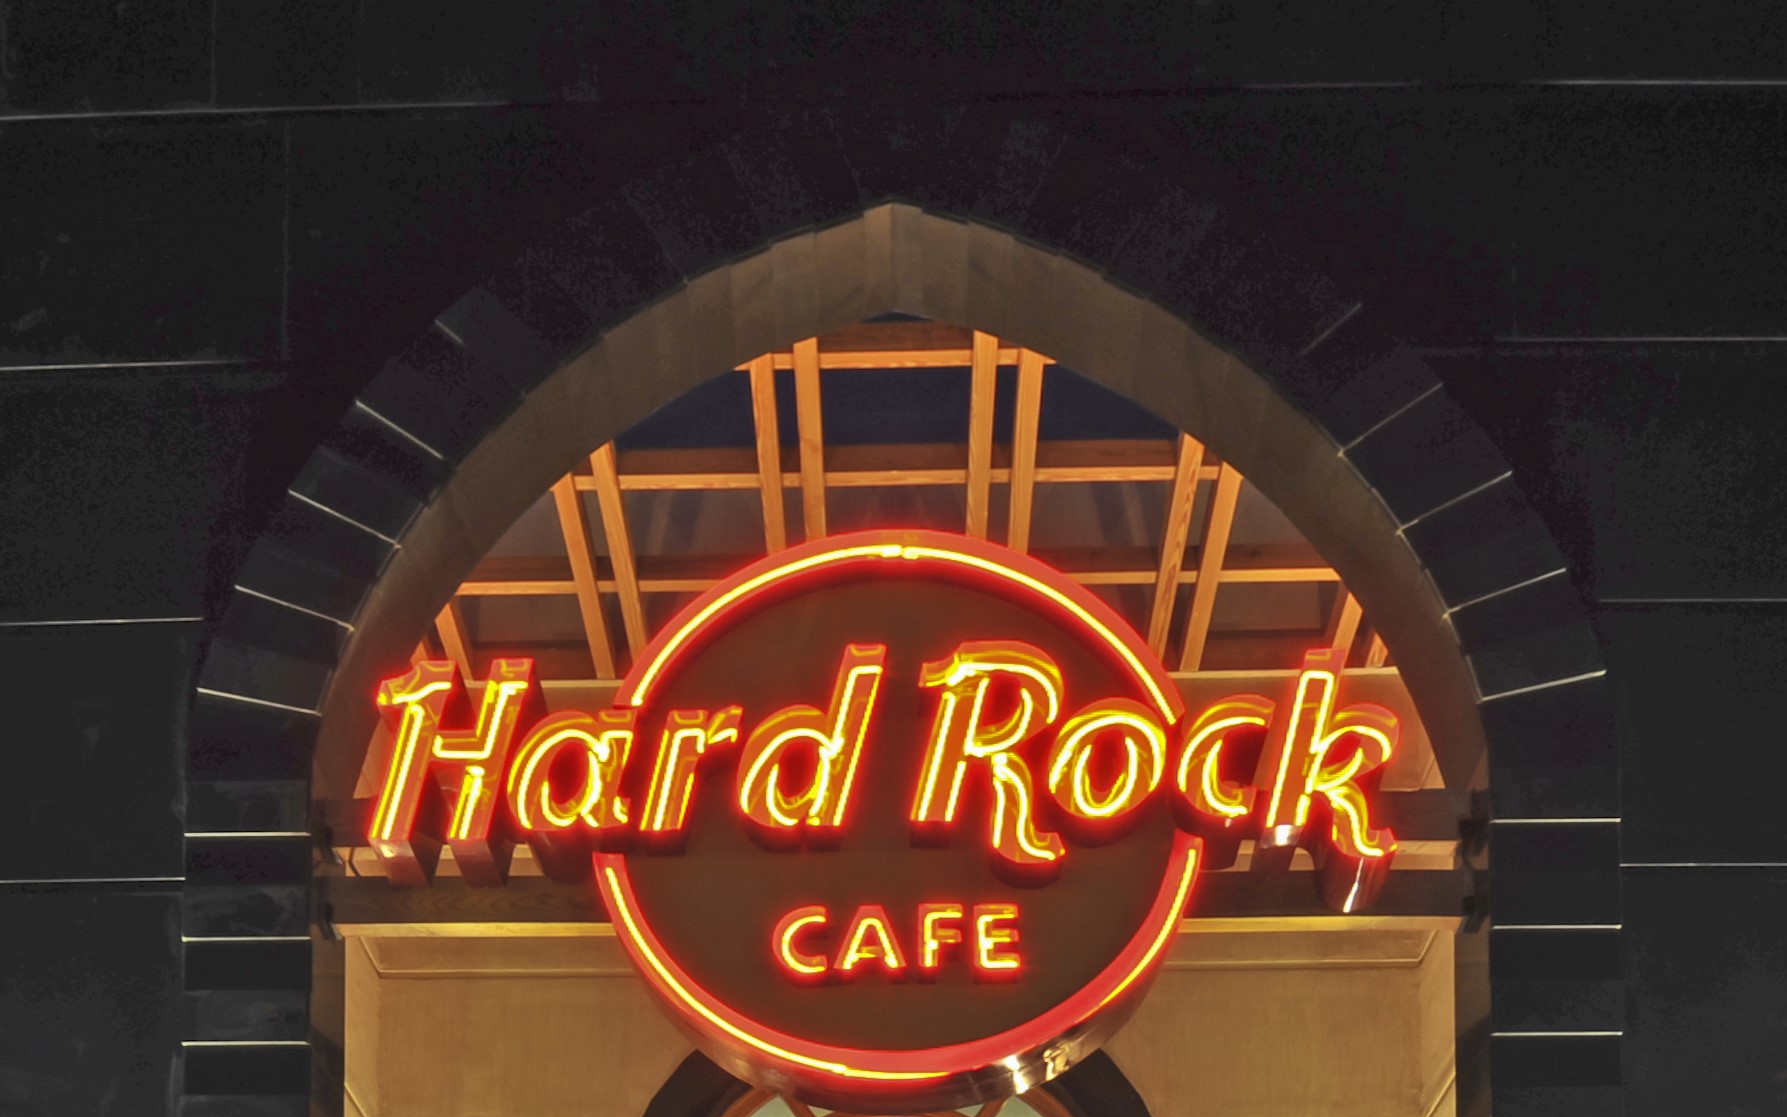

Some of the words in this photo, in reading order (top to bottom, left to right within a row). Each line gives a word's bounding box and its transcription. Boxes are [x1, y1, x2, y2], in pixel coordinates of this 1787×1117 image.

[369, 643, 888, 868] Hard
[908, 638, 1401, 874] Rock
[771, 902, 1023, 979] CAFE
